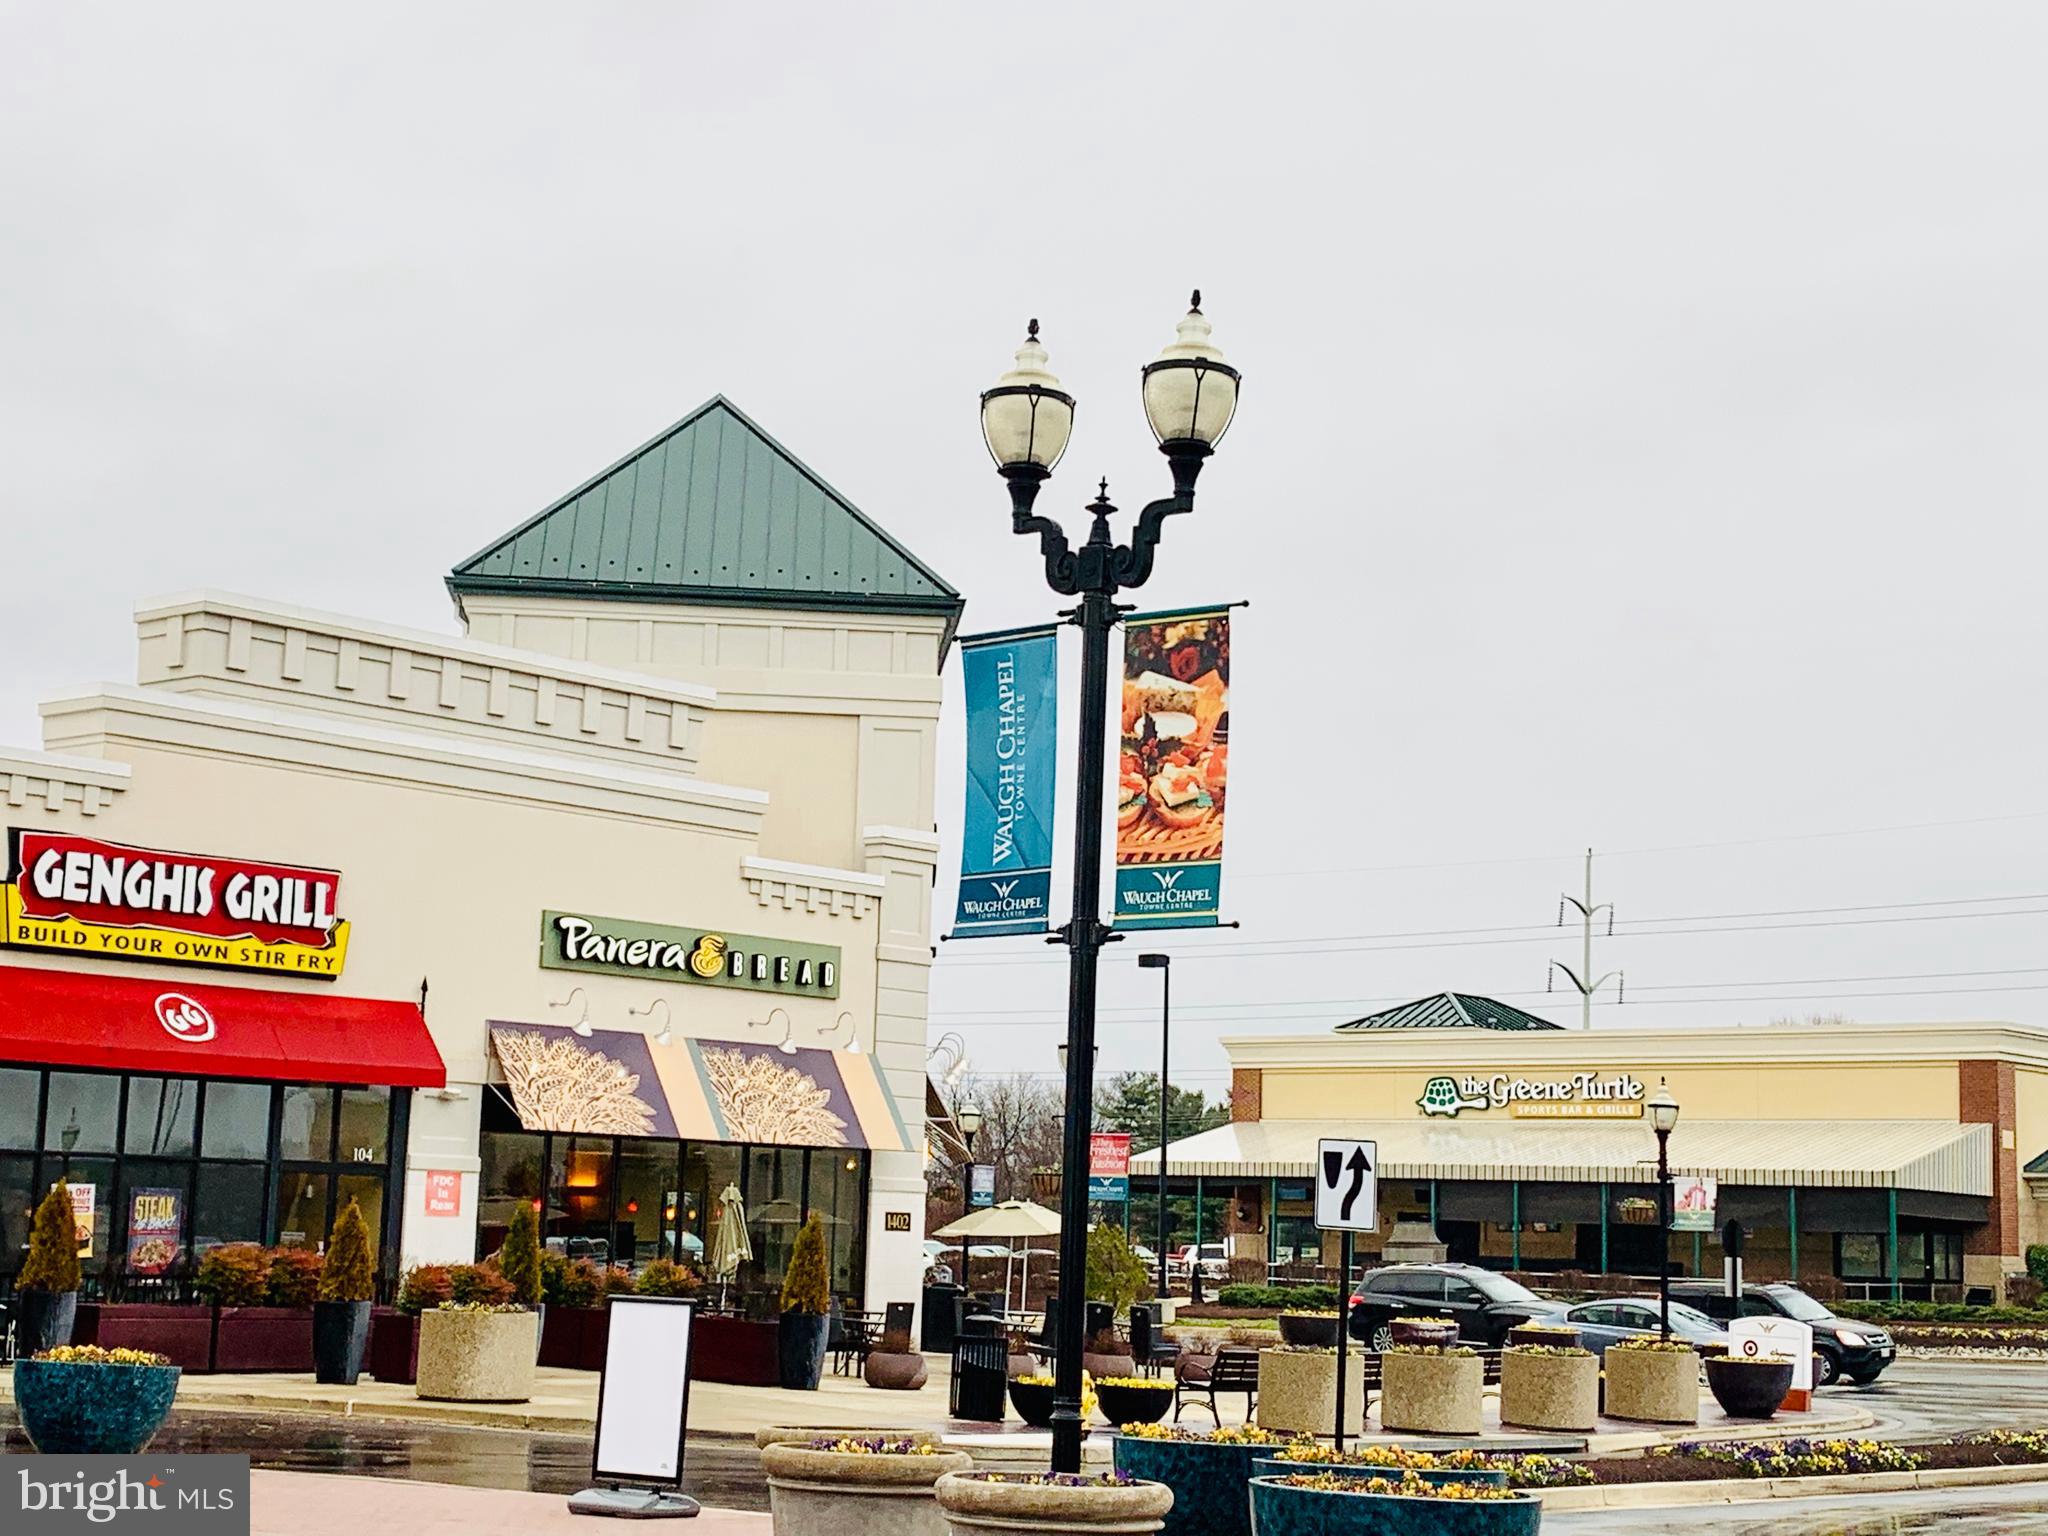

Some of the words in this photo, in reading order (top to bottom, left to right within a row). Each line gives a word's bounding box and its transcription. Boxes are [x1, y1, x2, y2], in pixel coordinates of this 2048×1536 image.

[996, 652, 1016, 760] CHAPEL
[1016, 693, 1026, 756] CENTRE
[1014, 762, 1025, 822] TOWNE
[993, 762, 1015, 867] WAUGH
[33, 848, 215, 917] GENGHIS
[225, 872, 336, 929] GRILL
[1122, 890, 1165, 905] WAUGH
[1166, 888, 1212, 902] CHAPEL
[963, 900, 1002, 914] WAUGH
[1002, 897, 1043, 911] CHAPEL
[18, 925, 87, 945] BUILD
[100, 934, 163, 953] YOUR
[175, 941, 229, 960] OWN
[240, 948, 286, 966] STIR
[297, 954, 336, 971] FRY
[556, 915, 686, 972] Panera
[731, 951, 835, 988] BREAD
[165, 1003, 205, 1032] GG
[1461, 1075, 1489, 1095] the
[1488, 1073, 1575, 1108] Greene
[1572, 1072, 1645, 1101] Turtle
[1517, 1103, 1559, 1116] SPORTS
[1561, 1103, 1584, 1116] BAR
[1585, 1104, 1594, 1115] &
[1596, 1103, 1635, 1116] GRILLE
[353, 1147, 374, 1162] 104
[75, 1187, 92, 1197] OFF
[433, 1175, 455, 1187] FDC
[134, 1195, 176, 1220] STEAK
[430, 1199, 455, 1211] Rear
[887, 1213, 909, 1230] 1402
